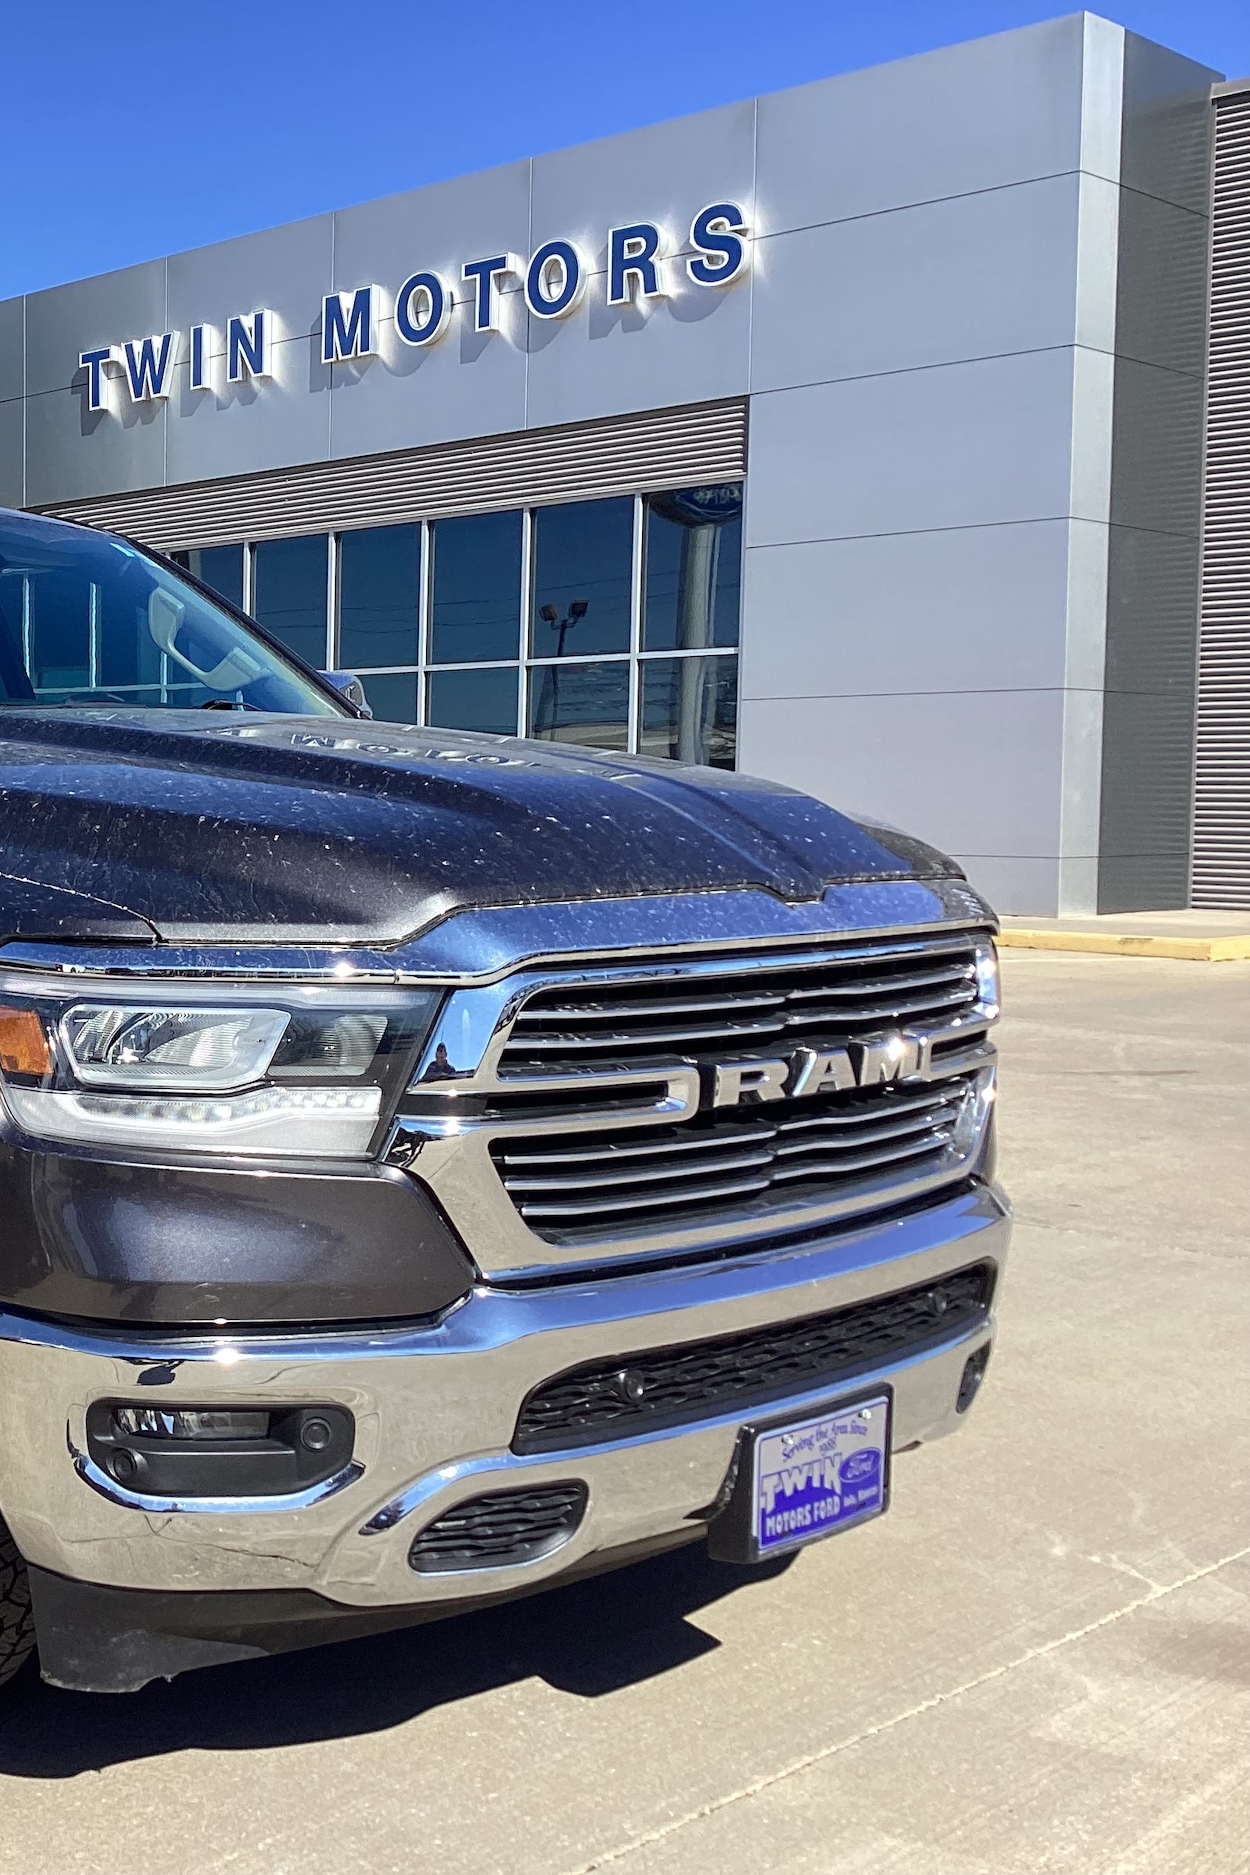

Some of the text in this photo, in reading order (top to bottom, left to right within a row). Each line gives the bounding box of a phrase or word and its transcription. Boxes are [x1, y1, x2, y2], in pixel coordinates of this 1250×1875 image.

[79, 200, 753, 411] TWIN MOTORS
[714, 1034, 920, 1108] RAM
[760, 1452, 842, 1515] TWIN
[765, 1503, 812, 1537] MOTORS
[813, 1495, 841, 1522] FORD
